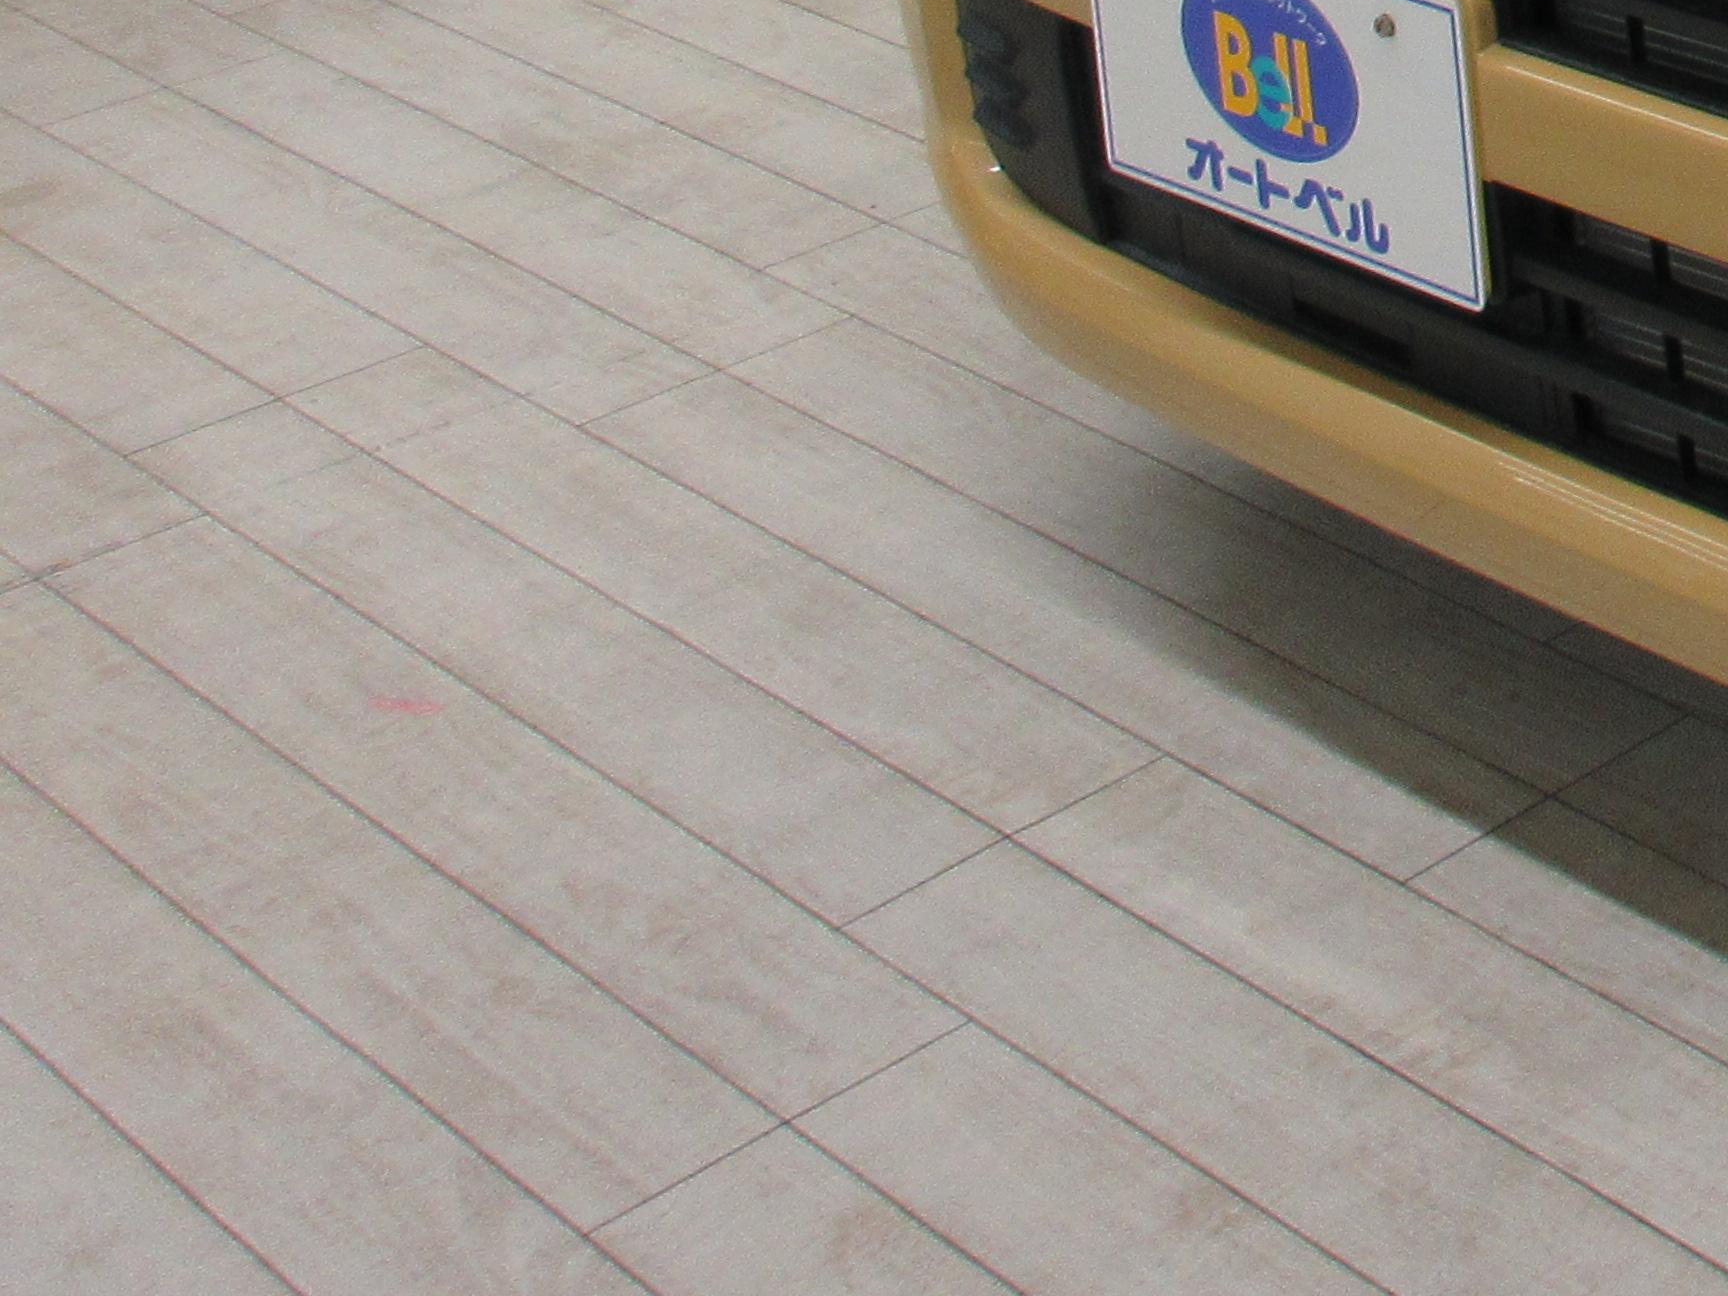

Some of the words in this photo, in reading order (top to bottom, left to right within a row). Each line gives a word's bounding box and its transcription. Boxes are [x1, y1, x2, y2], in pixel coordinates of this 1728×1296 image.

[1185, 137, 1391, 255] オートベル
